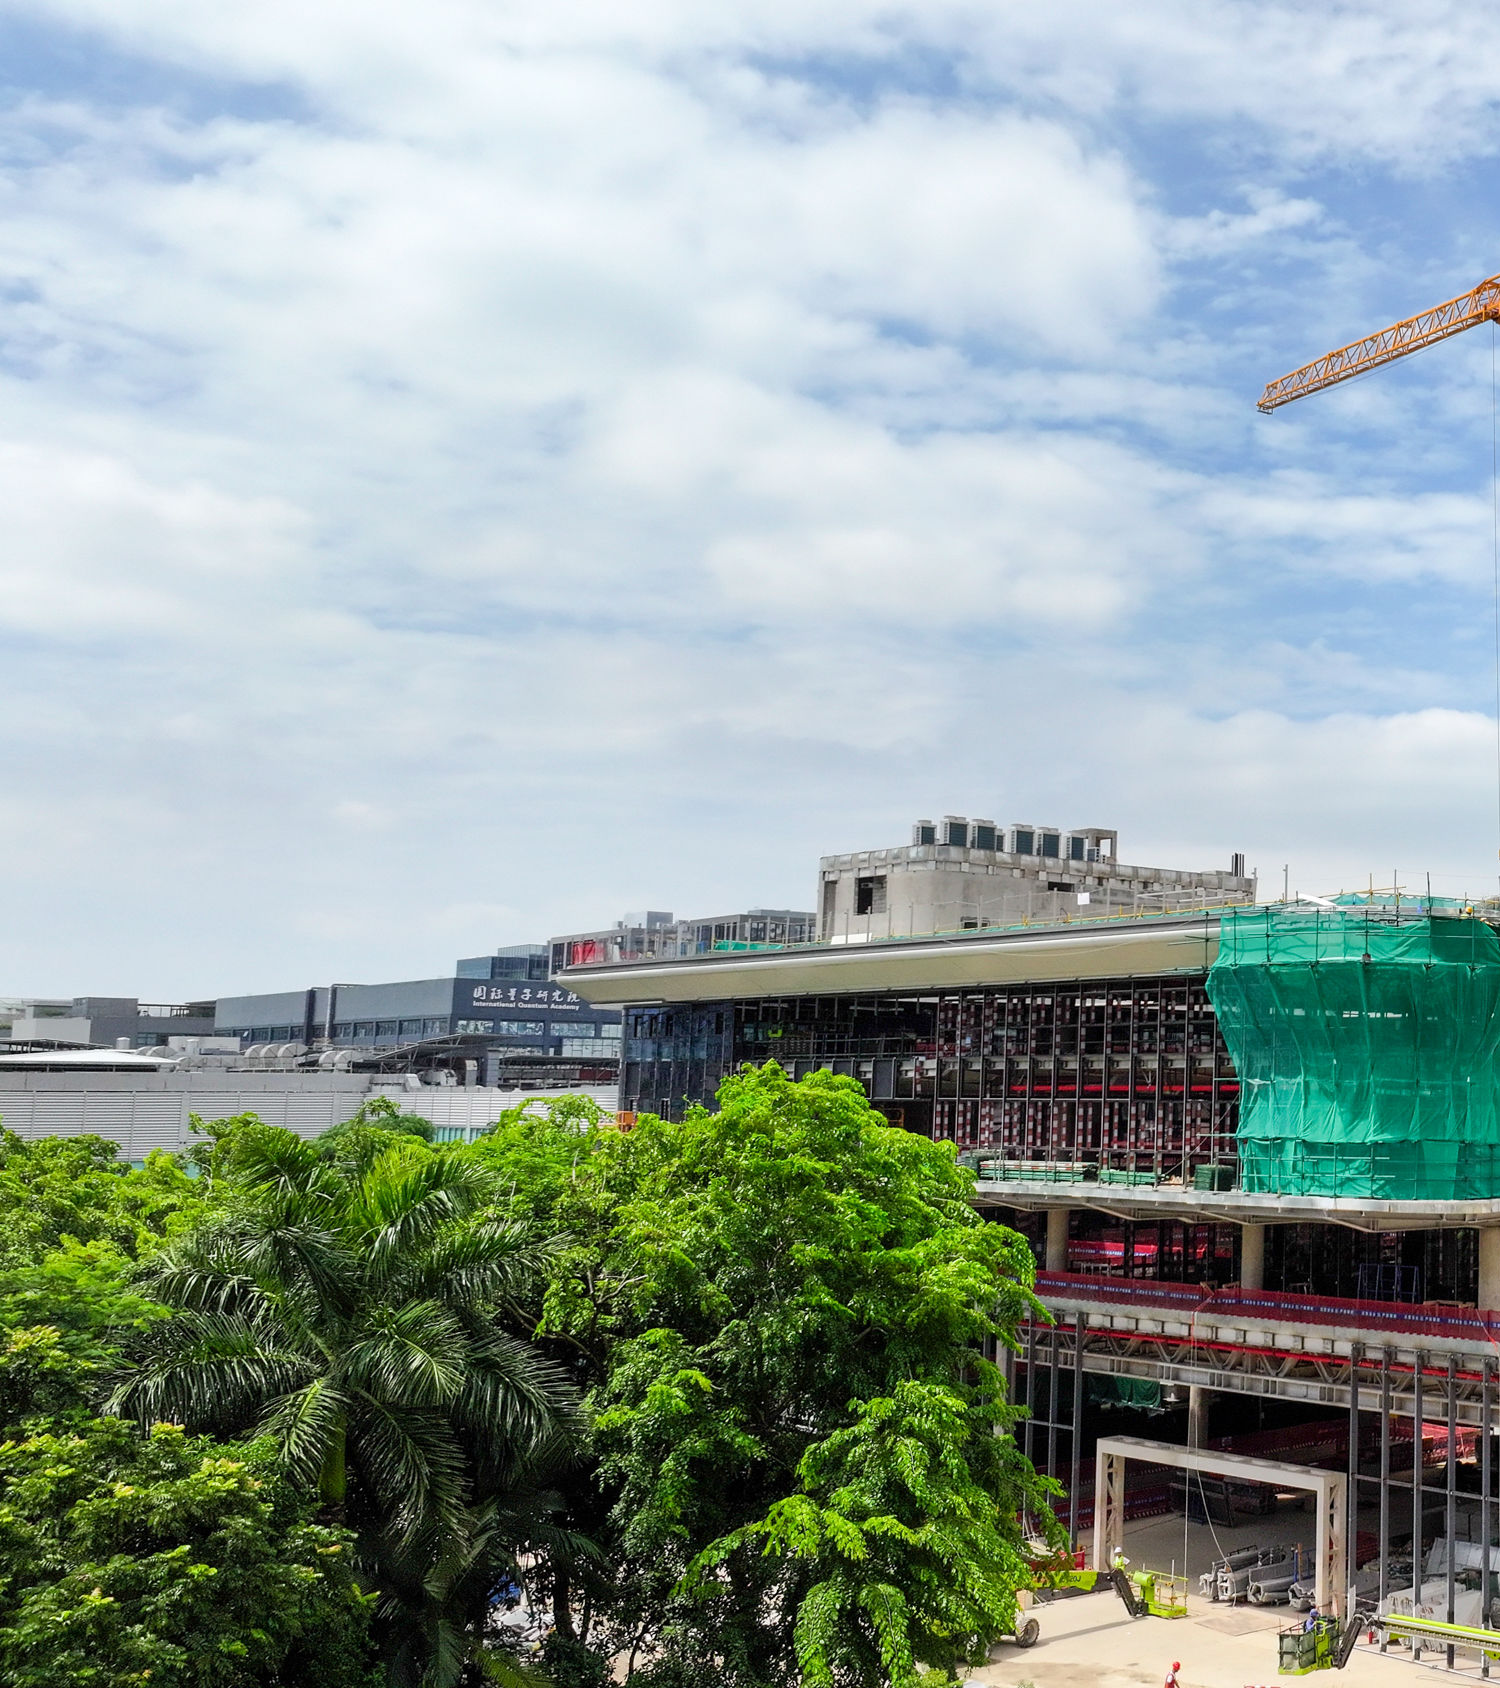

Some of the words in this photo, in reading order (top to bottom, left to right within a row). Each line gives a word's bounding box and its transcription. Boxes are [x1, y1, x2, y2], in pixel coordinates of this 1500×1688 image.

[472, 1000, 516, 1009] International
[518, 1001, 548, 1010] Quantum
[550, 1003, 580, 1011] Academy
